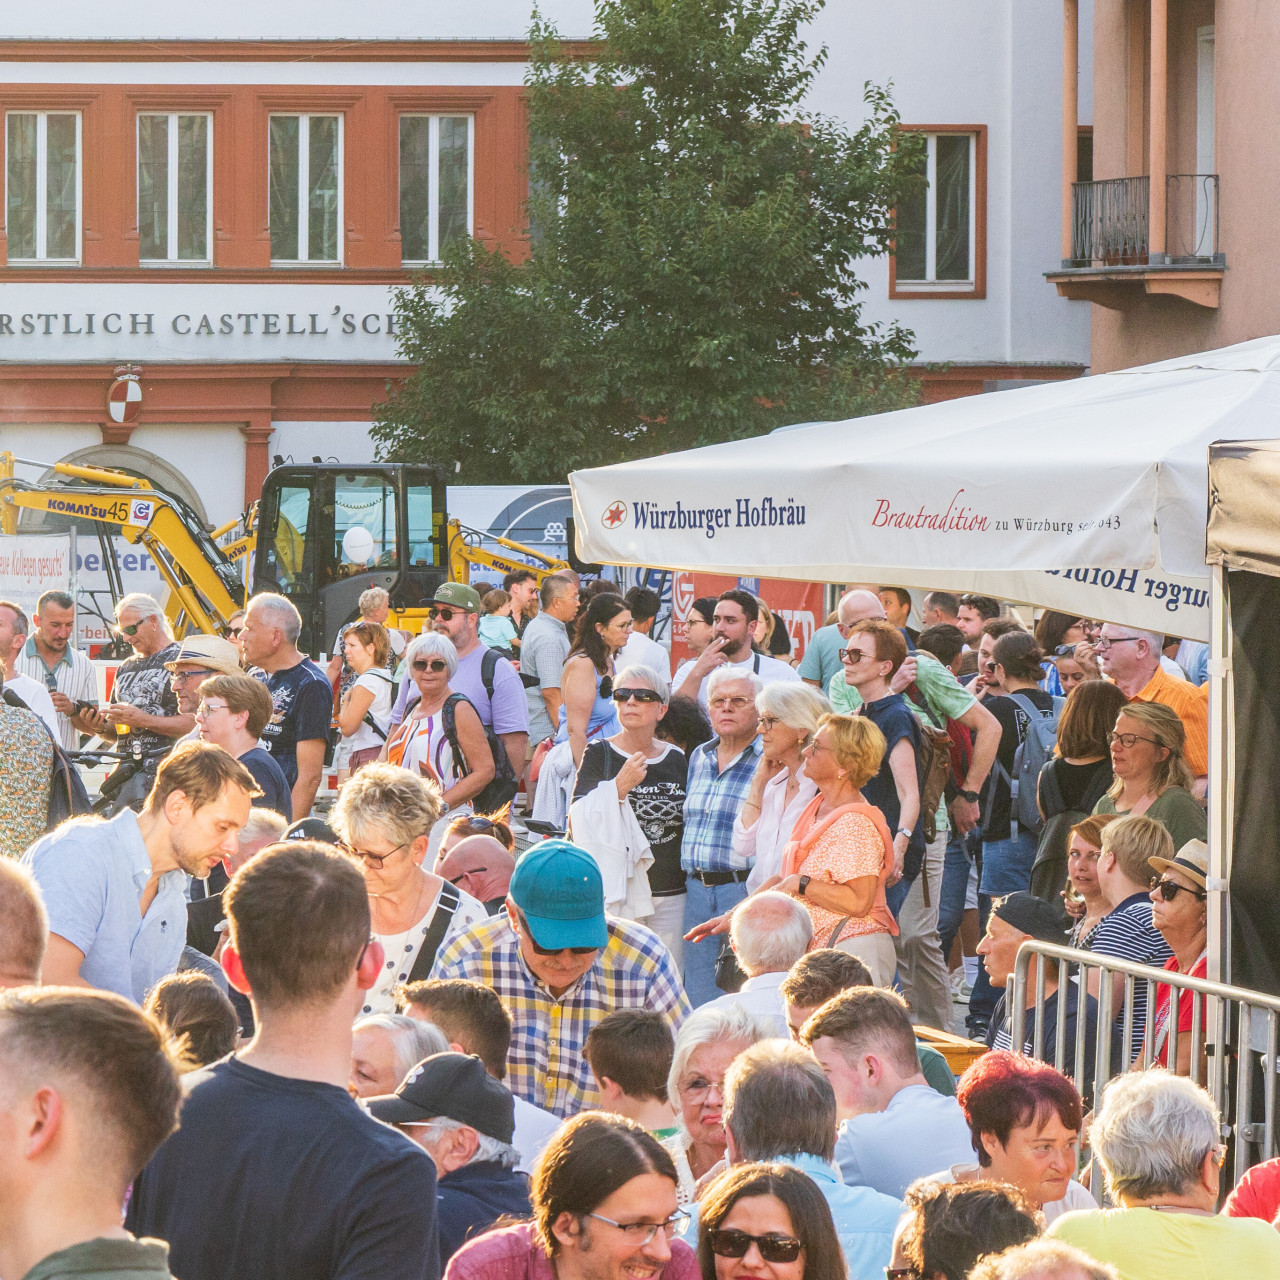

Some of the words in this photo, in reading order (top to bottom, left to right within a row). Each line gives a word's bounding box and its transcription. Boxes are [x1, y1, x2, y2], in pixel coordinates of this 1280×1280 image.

[47, 499, 108, 519] KOMATSU
[107, 501, 129, 522] 45
[632, 500, 732, 539] Würzburger
[735, 497, 806, 528] Hofbräu
[871, 488, 991, 533] Brautradition
[995, 519, 1009, 531] zu
[1013, 517, 1073, 535] Würzburg
[11, 549, 38, 584] Kollegen
